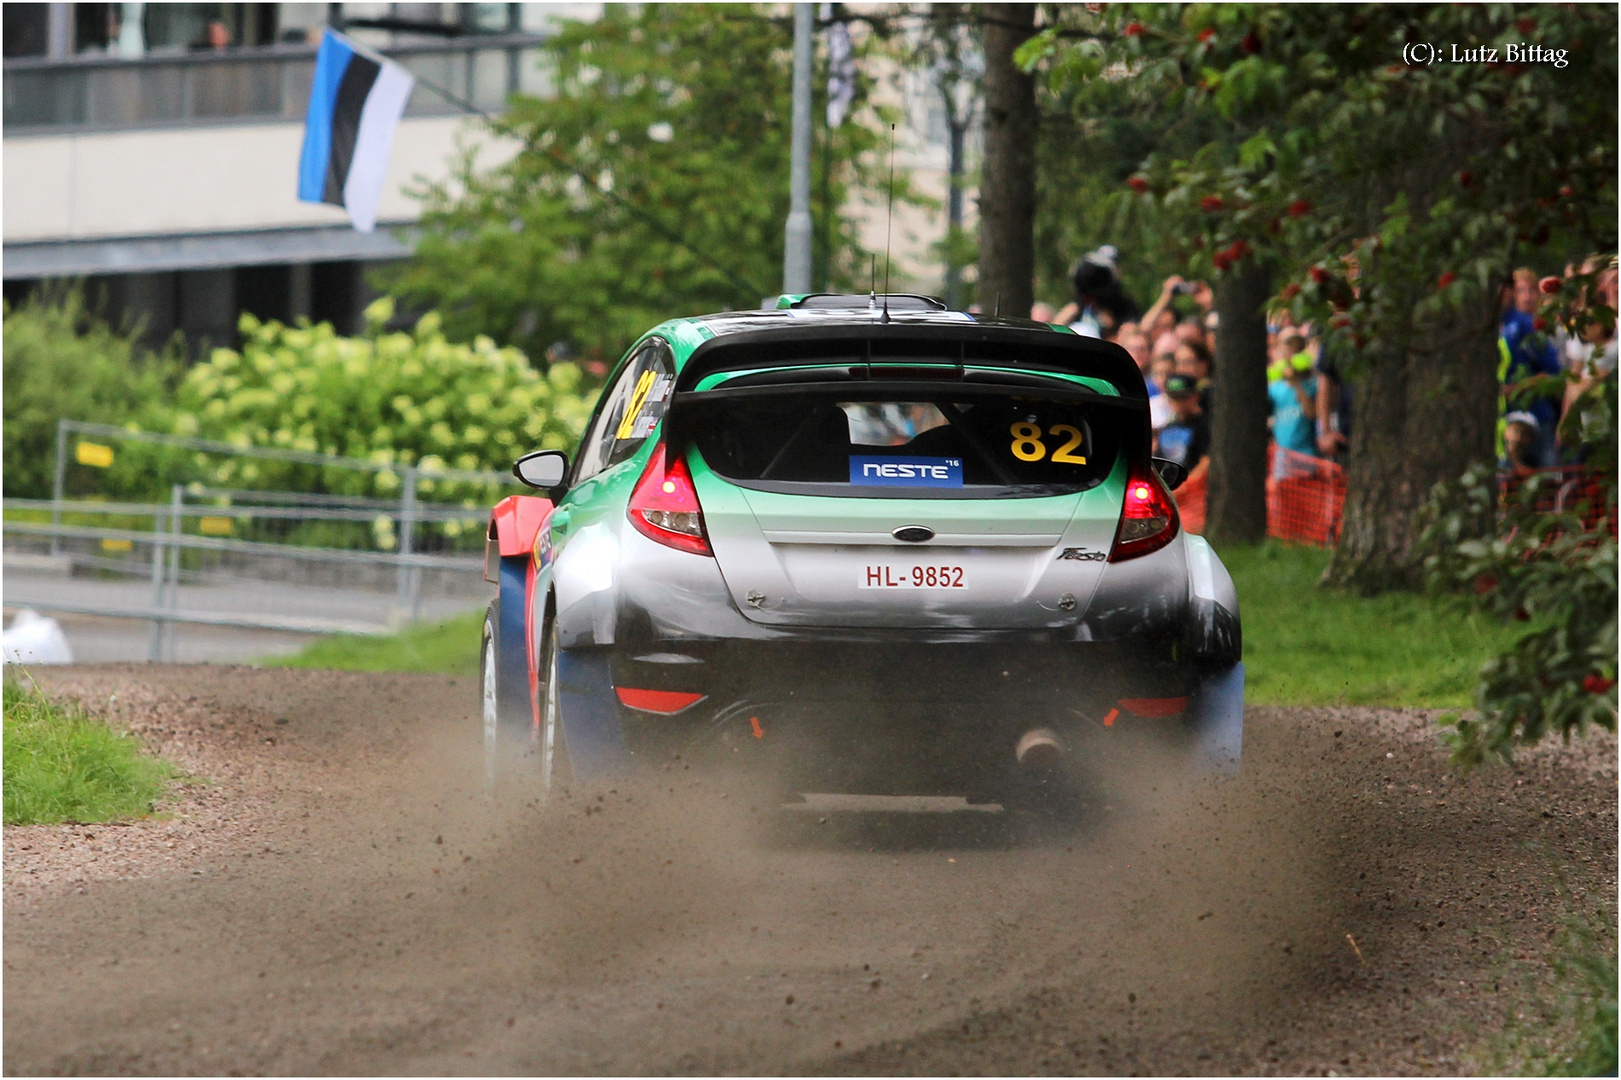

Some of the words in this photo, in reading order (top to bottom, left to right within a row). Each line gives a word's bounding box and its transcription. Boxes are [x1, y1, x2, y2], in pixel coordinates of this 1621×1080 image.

[1009, 421, 1087, 465] 82
[863, 462, 949, 479] NESTE
[912, 565, 964, 587] 9852
